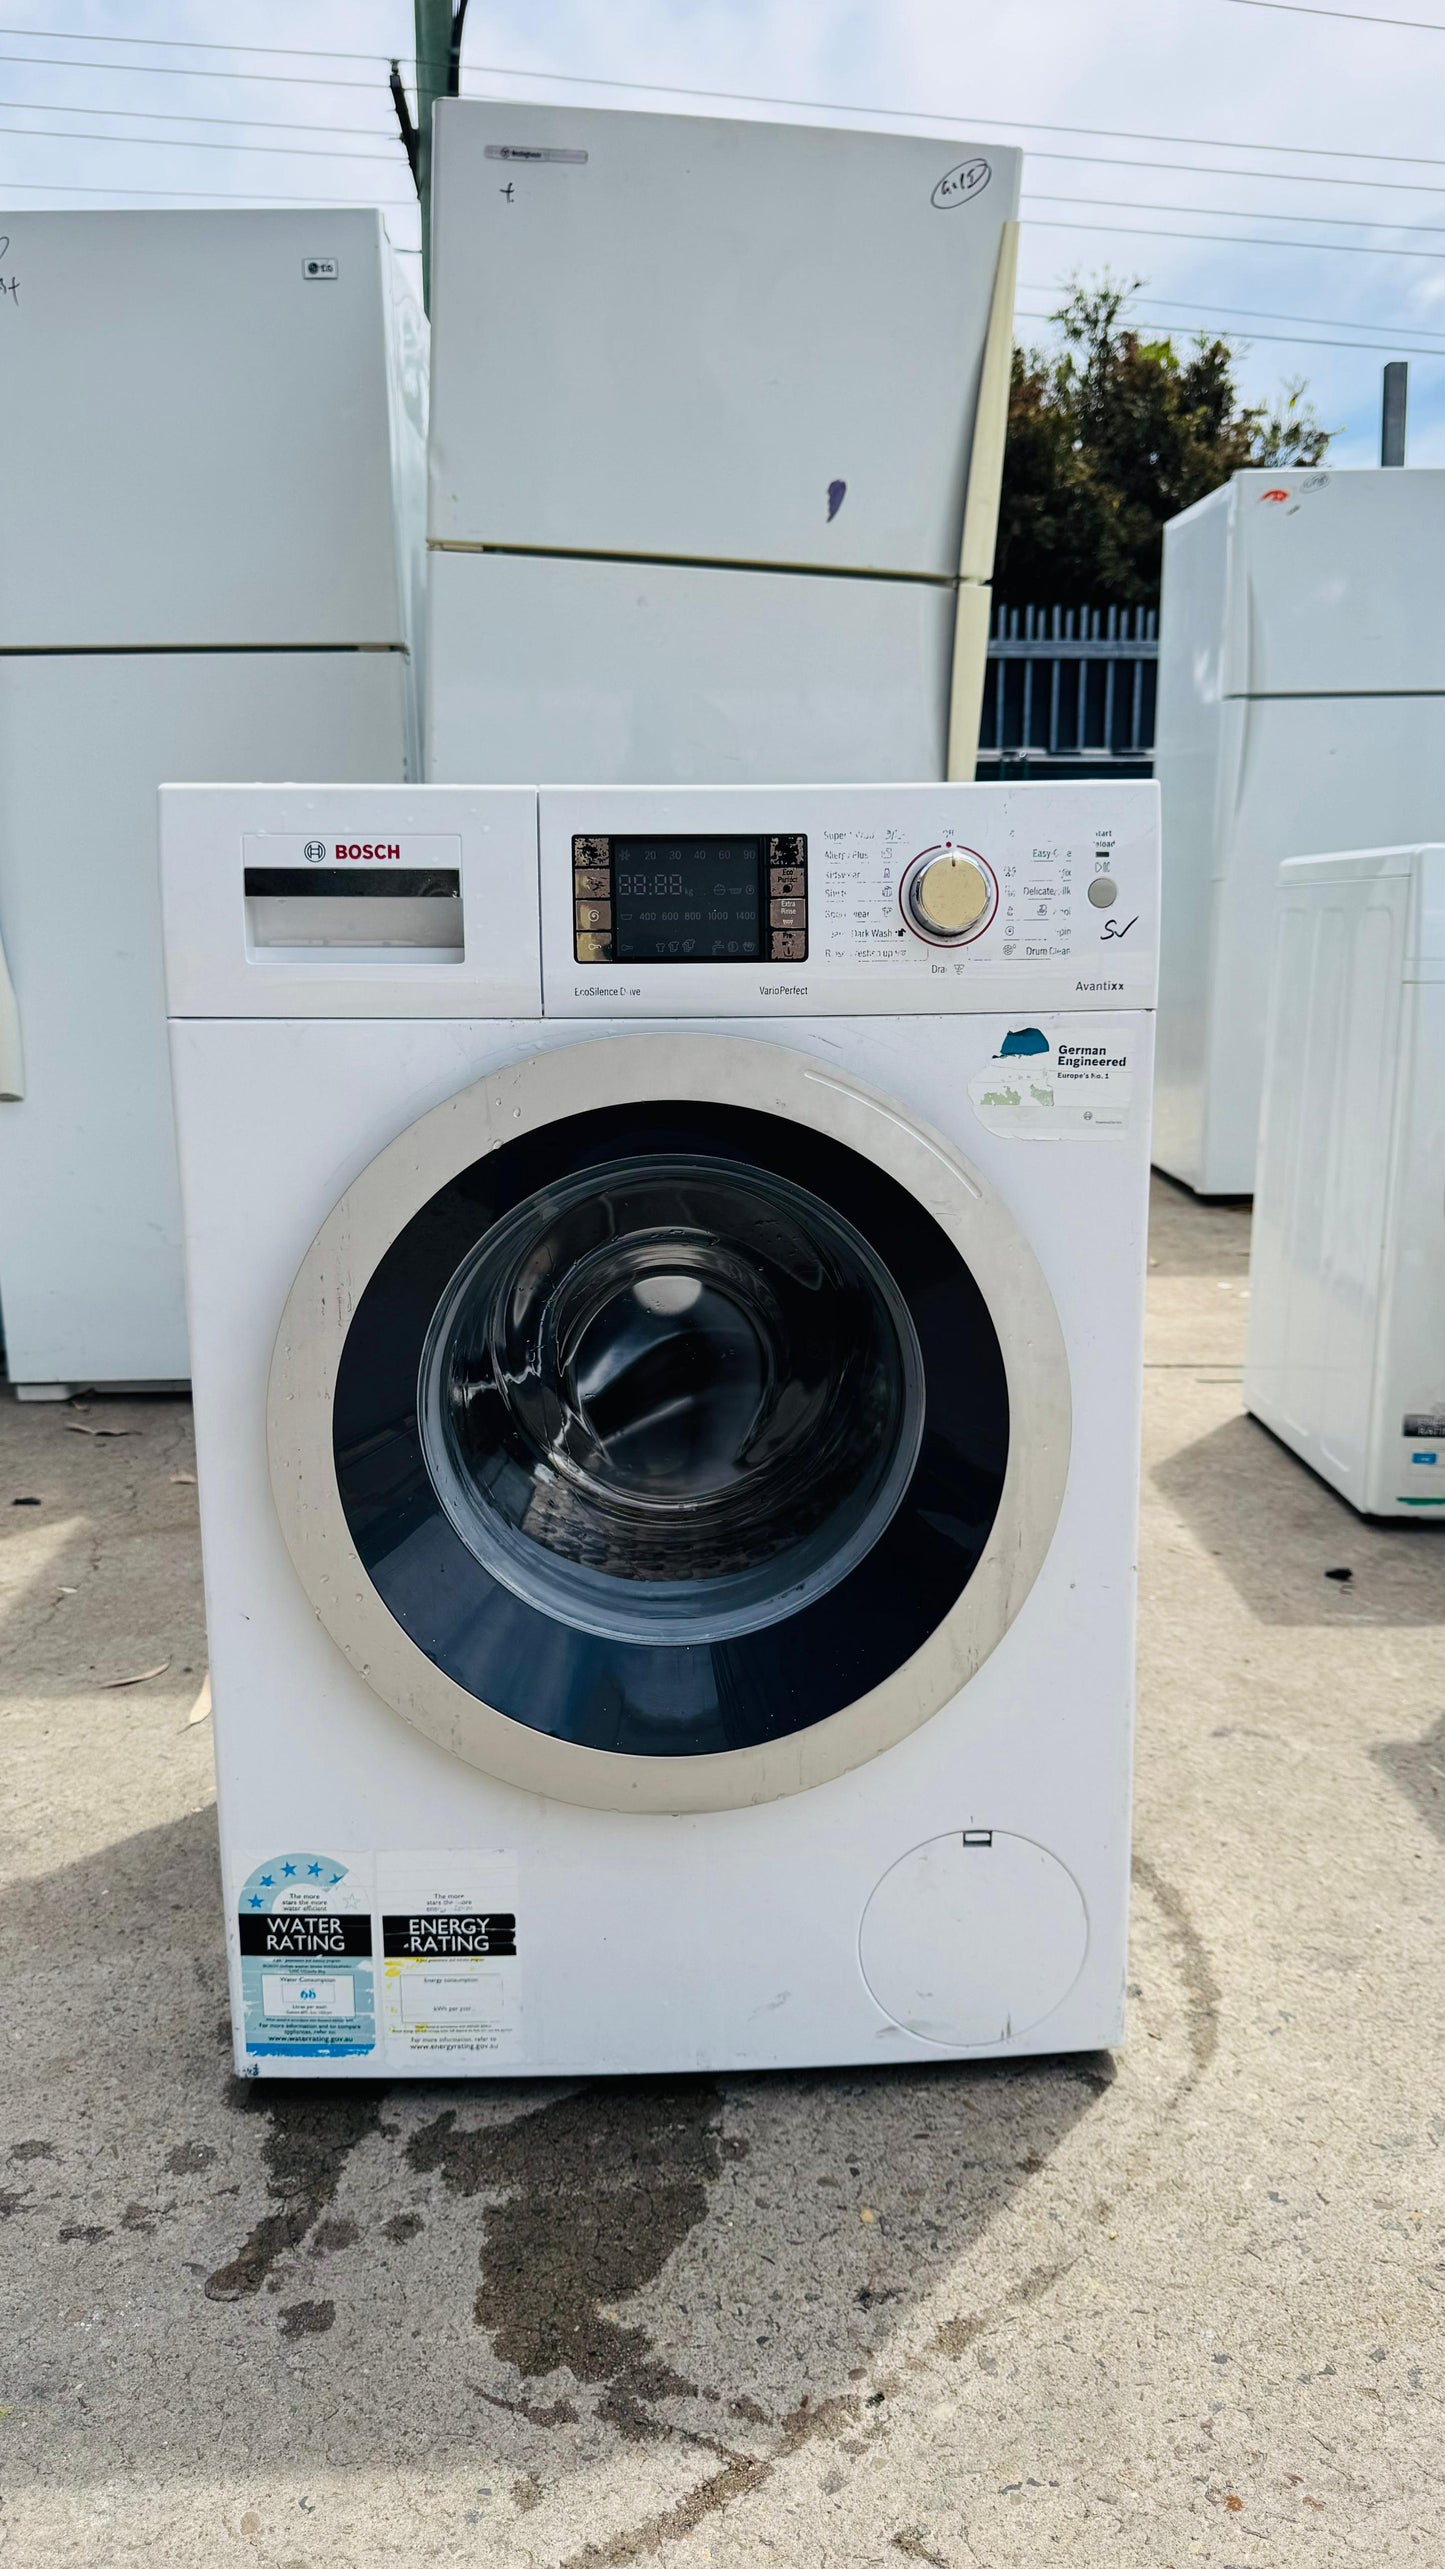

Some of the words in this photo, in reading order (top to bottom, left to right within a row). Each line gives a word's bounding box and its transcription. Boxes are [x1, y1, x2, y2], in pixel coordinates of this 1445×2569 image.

[823, 831, 846, 842] Super
[335, 844, 400, 859] BOSCH
[645, 850, 657, 860] 20
[669, 850, 682, 860] 30
[694, 850, 706, 860] 40
[718, 850, 731, 860] 60
[743, 850, 756, 860] 90
[1032, 849, 1051, 859] Easy
[639, 912, 657, 921] 400
[661, 912, 679, 921] 600
[684, 912, 701, 921] 800
[708, 911, 729, 921] 1000
[736, 911, 756, 921] 1400
[871, 929, 892, 938] Wash
[1026, 947, 1047, 956] Drum
[760, 985, 808, 995] VarioPerfect
[1076, 980, 1124, 991] Avantixx
[574, 986, 618, 997] EcoSilence
[1058, 1045, 1107, 1056] German
[1058, 1056, 1127, 1068] Engineered
[1057, 1072, 1089, 1080] Europe's
[267, 1918, 343, 1934] WATER
[409, 1918, 490, 1935] ENERGY
[267, 1935, 346, 1951] RATING
[411, 1936, 490, 1952] RATING
